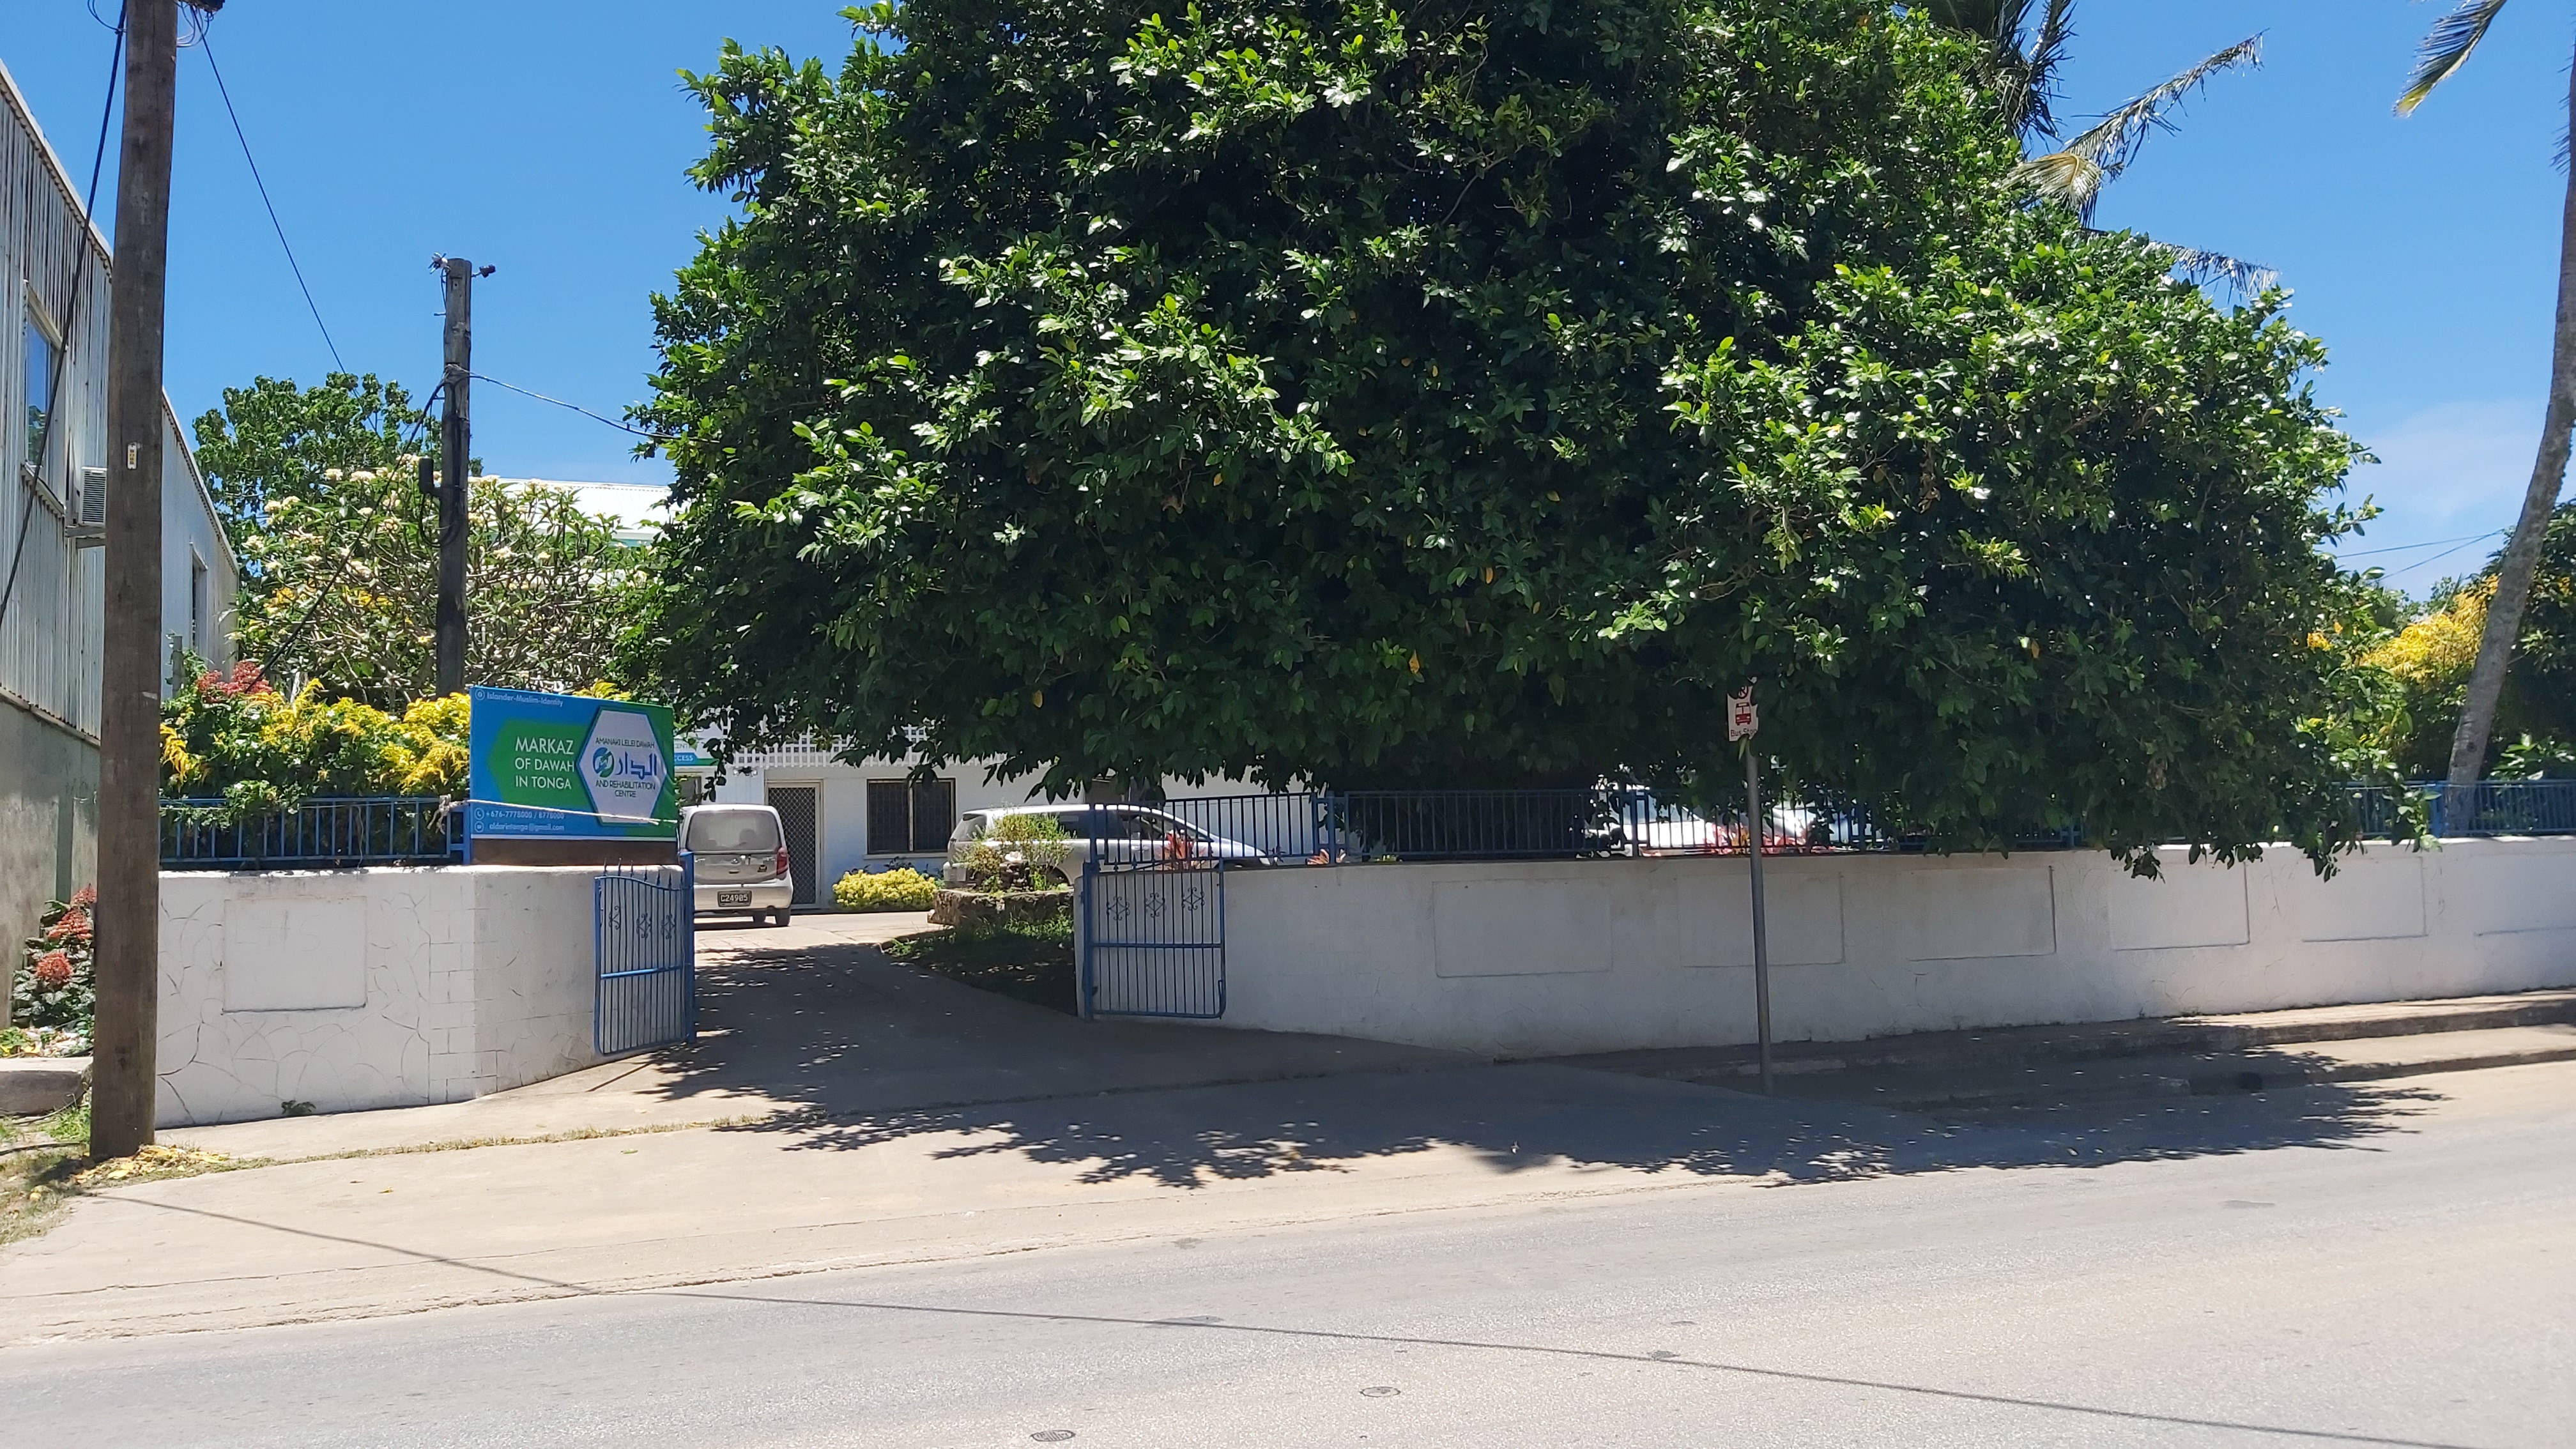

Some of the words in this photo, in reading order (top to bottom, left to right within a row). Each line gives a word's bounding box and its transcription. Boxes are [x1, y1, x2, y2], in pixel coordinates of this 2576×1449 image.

[515, 737, 574, 755] MARKAZ
[515, 758, 531, 770] OF
[534, 758, 574, 772] DAWAH
[516, 775, 528, 788] IN
[531, 776, 572, 790] TONGA
[610, 780, 656, 790] REHABILITATION
[615, 790, 637, 798] CENTRE
